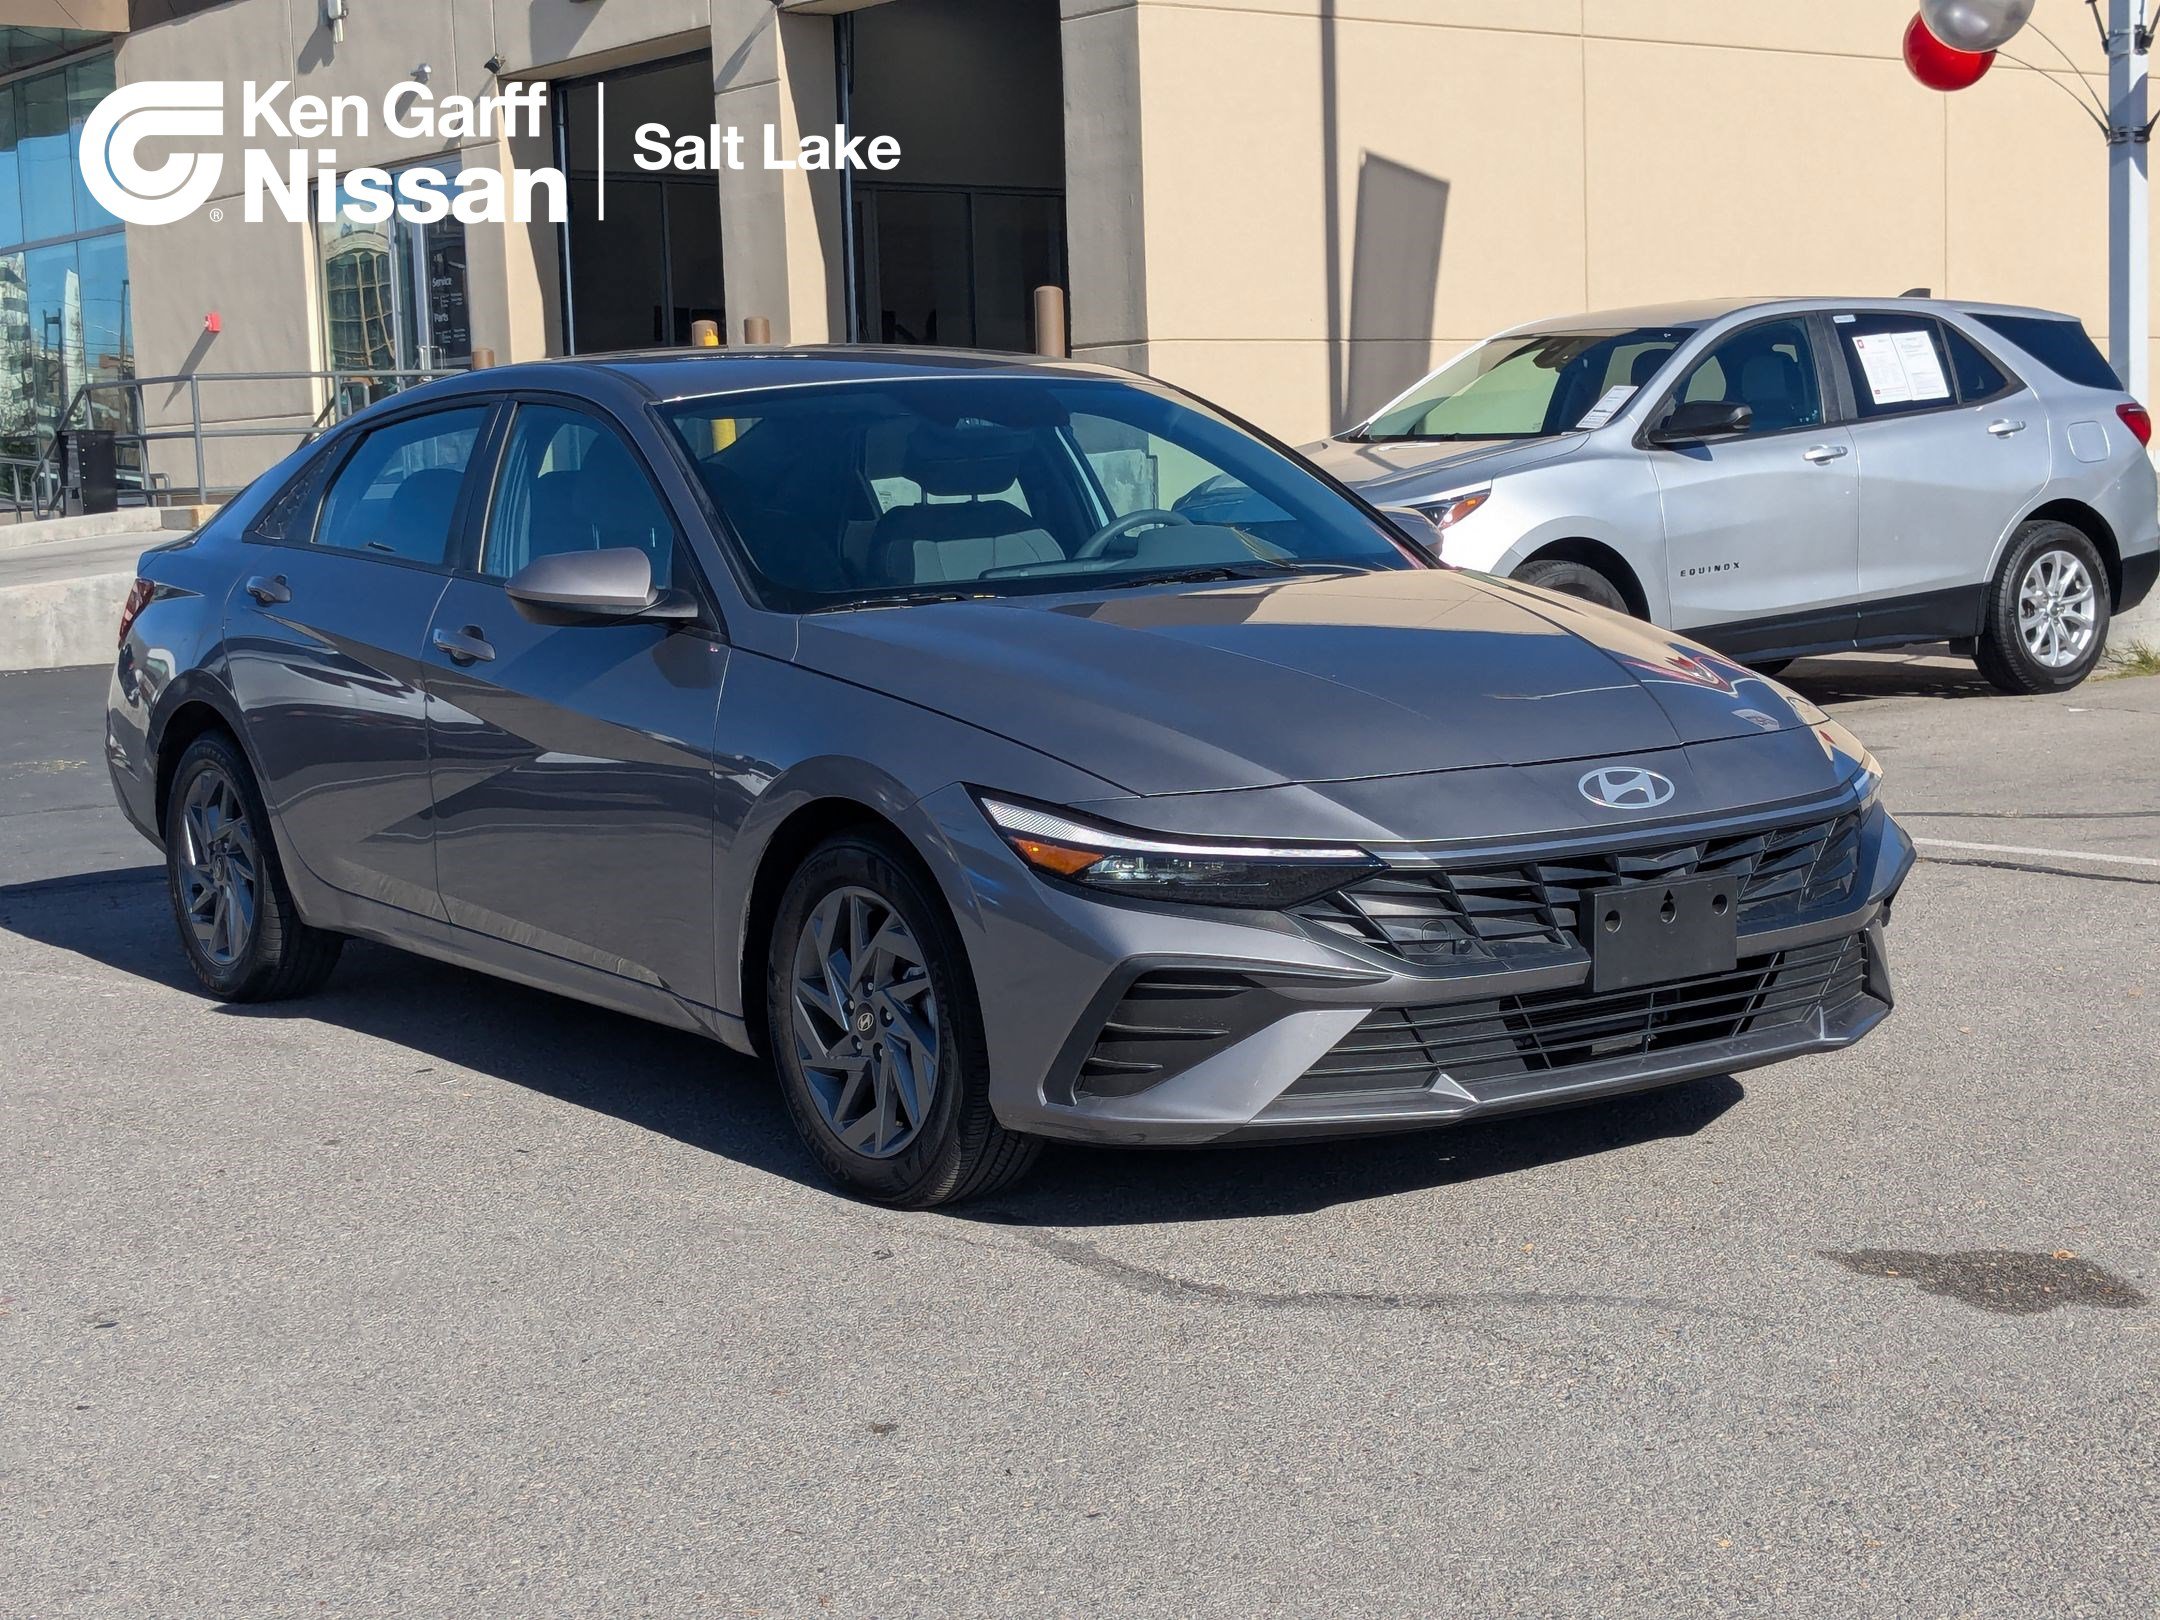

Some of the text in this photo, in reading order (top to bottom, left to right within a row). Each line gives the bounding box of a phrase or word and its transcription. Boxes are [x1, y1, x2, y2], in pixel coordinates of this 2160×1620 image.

[432, 277, 452, 288] Service
[434, 312, 449, 323] Parts
[1680, 562, 1740, 577] EQUINOX
